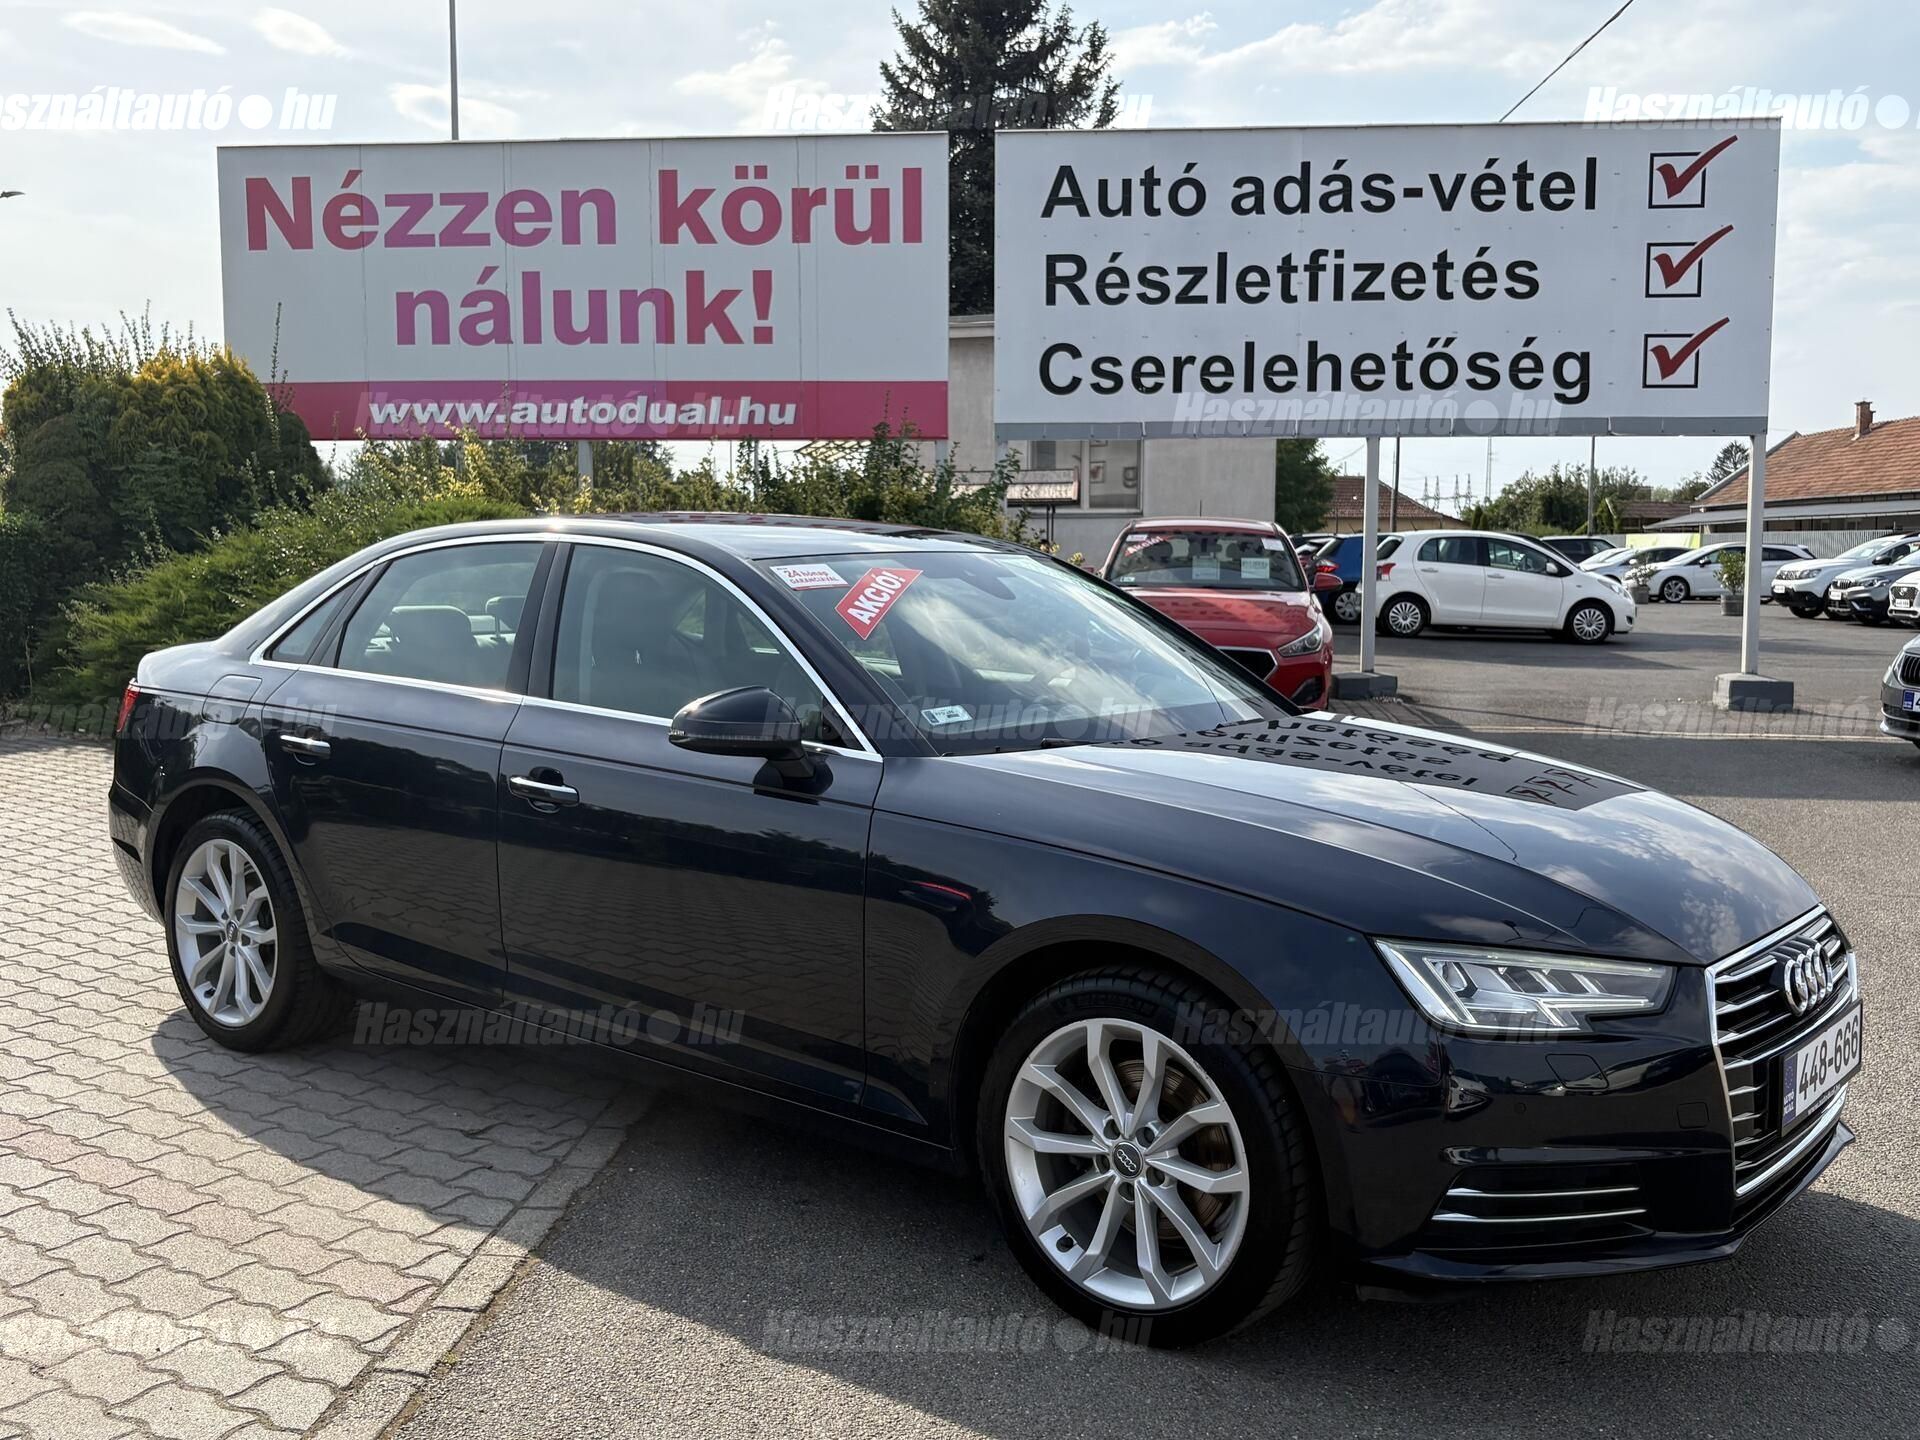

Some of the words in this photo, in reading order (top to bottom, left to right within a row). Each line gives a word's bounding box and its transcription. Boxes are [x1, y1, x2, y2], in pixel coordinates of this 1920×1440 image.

[246, 169, 617, 251] Nézzen
[658, 165, 922, 245] körül
[1040, 162, 1207, 219] Autó
[1230, 157, 1598, 216] adás-vétel
[395, 266, 774, 346] nálunk!
[1045, 246, 1540, 306] Részletfizetés
[1039, 337, 1591, 405] Cserelehetőség
[368, 395, 797, 426] www.autodual.hu
[847, 570, 906, 625] AKCIÓ!
[1798, 1014, 1859, 1101] 448-666
